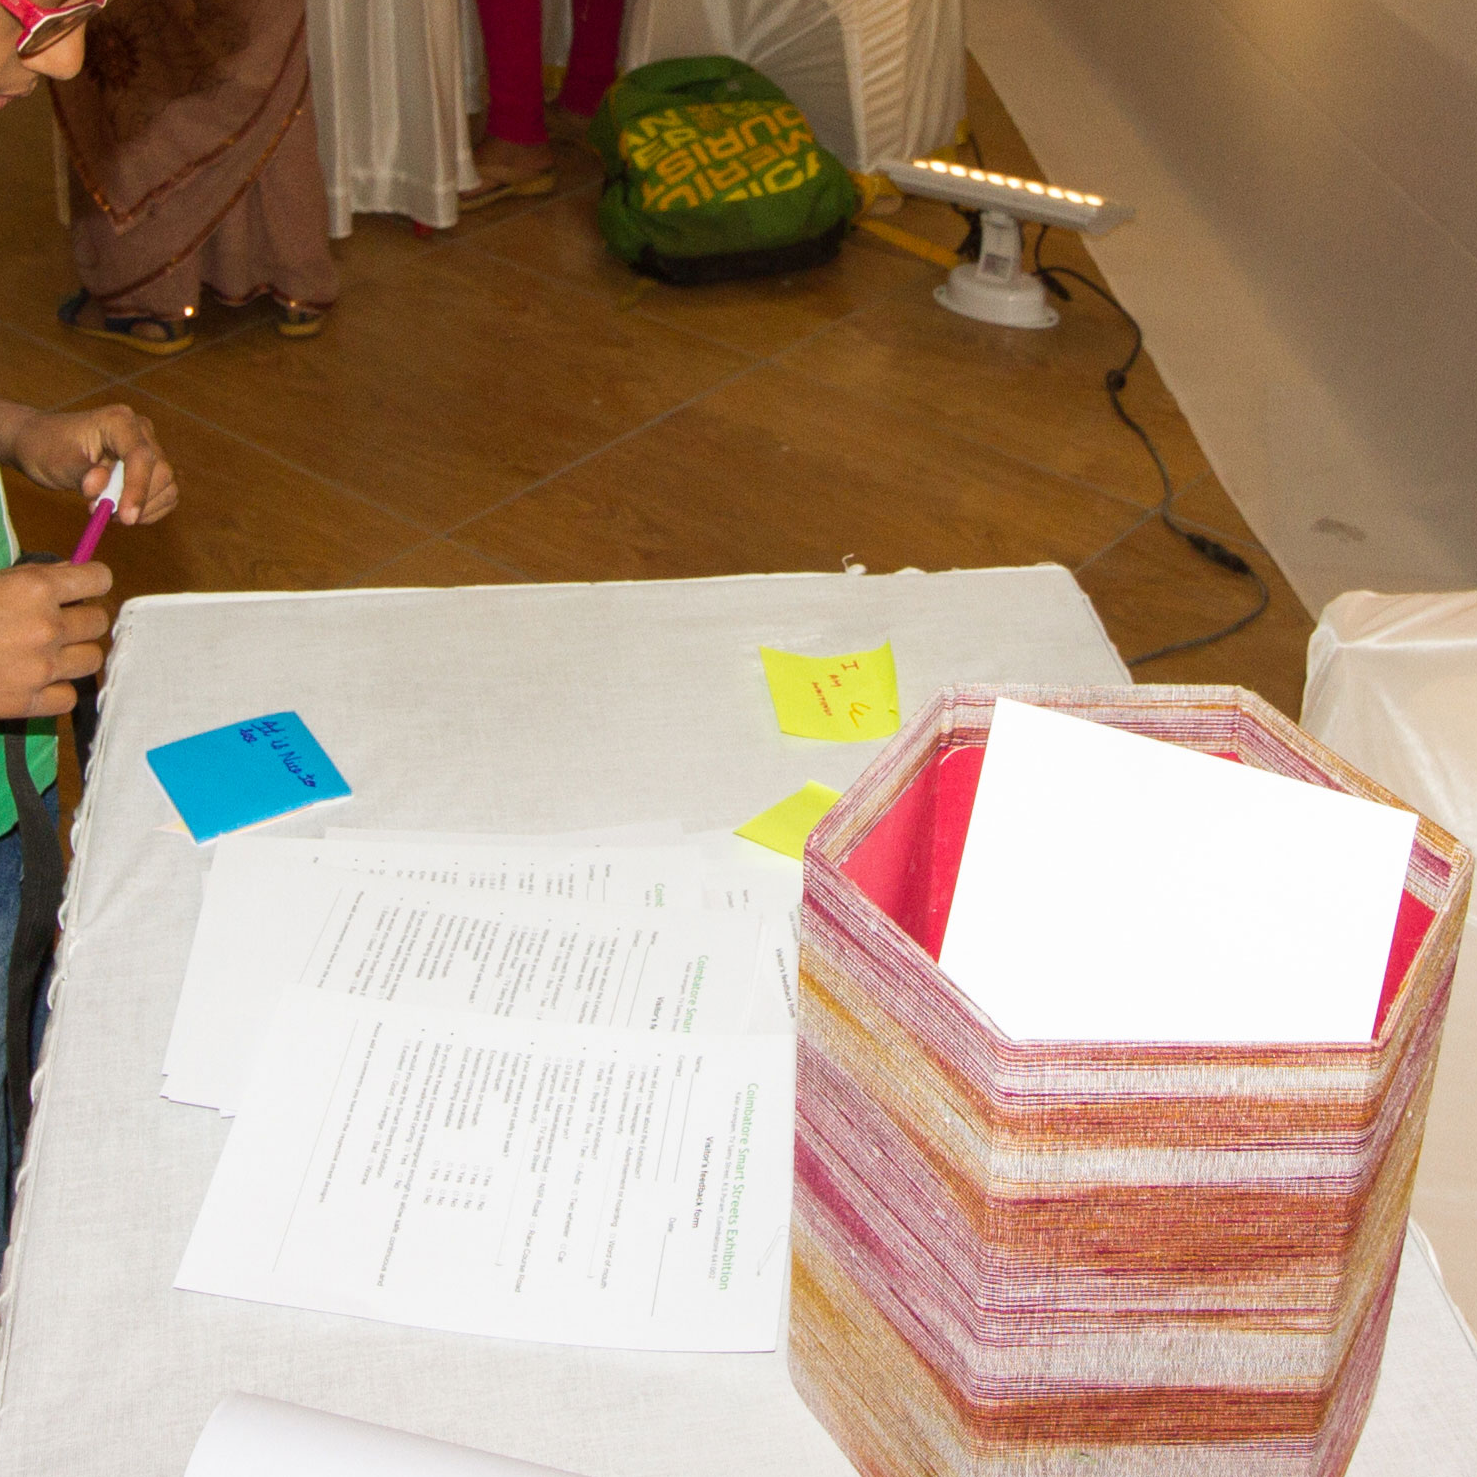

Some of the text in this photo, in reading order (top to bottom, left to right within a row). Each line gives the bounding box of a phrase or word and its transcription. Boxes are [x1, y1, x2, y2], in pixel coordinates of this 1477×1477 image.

[687, 954, 708, 1005] Coimbatore
[681, 1007, 697, 1033] Smart
[691, 1135, 714, 1229] Visitor's feedback form
[717, 1082, 759, 1291] Coimbatore Smart Streets Exhibition
